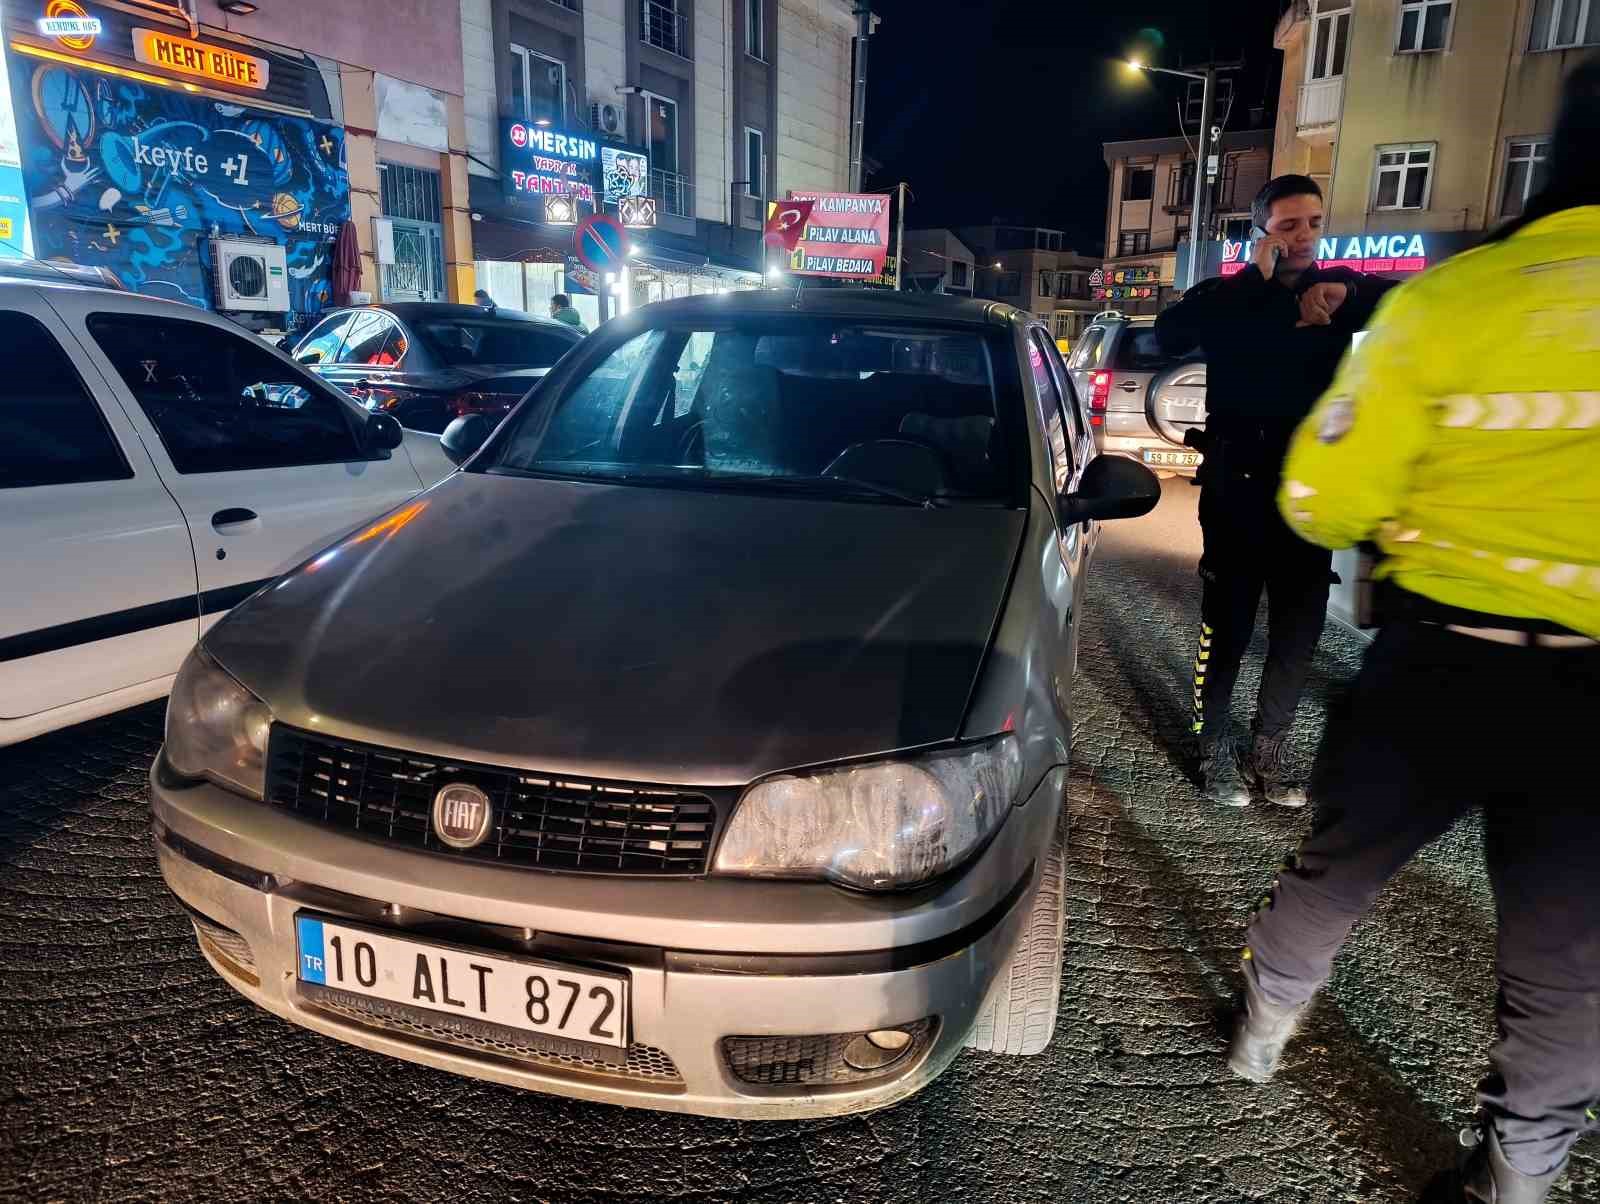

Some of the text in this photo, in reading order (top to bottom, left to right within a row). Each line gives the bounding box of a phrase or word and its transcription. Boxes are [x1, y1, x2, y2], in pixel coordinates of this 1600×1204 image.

[155, 39, 258, 83] MERT BÜFE
[131, 136, 249, 186] keyfe +1
[819, 197, 882, 214] KAMPANYA
[298, 221, 322, 233] MERT
[841, 229, 876, 244] ALANA
[1343, 235, 1425, 259] AMCA
[837, 257, 873, 273] BEDAVA
[444, 799, 480, 830] FIAT
[305, 955, 323, 971] TR
[330, 935, 377, 988] 10
[412, 953, 493, 1013] ALT
[525, 975, 615, 1039] 872
